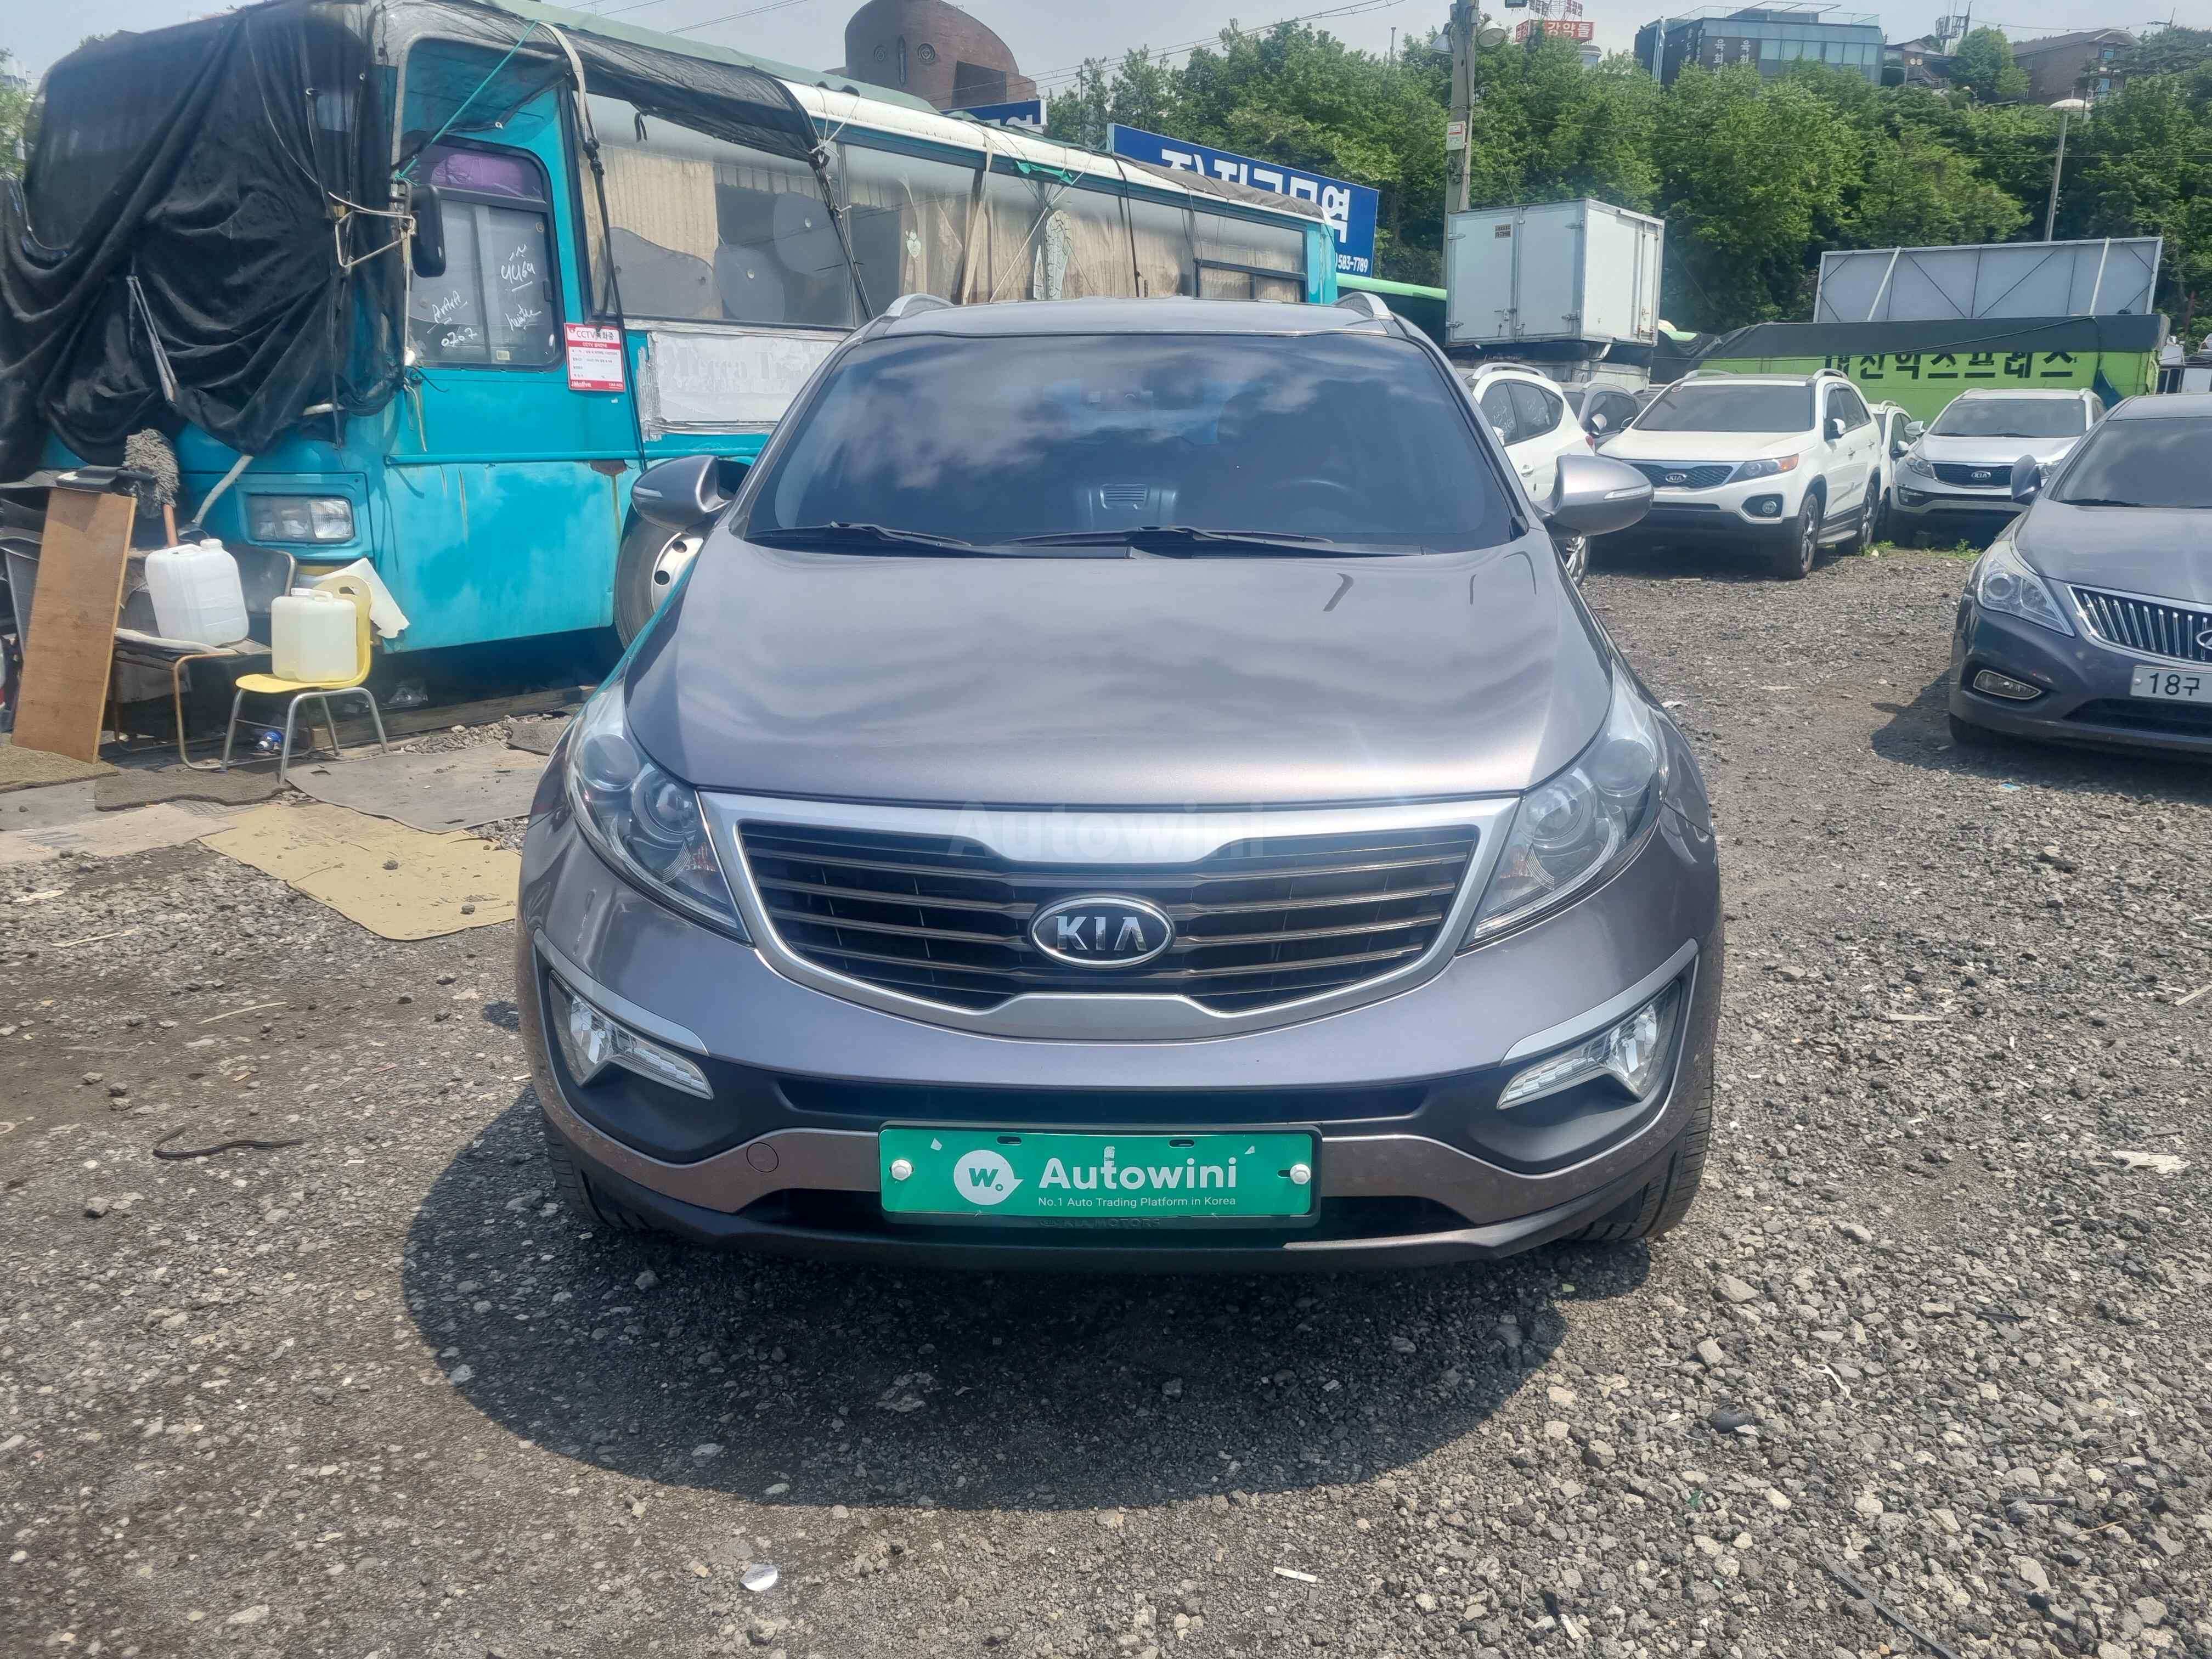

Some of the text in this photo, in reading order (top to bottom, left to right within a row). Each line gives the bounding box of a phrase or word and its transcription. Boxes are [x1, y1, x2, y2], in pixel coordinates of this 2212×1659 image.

[1055, 916, 1148, 951] KIA
[1039, 1155, 1237, 1189] Autowini
[1038, 1197, 1235, 1209] No.1 Auto Trading Platform in Korea
